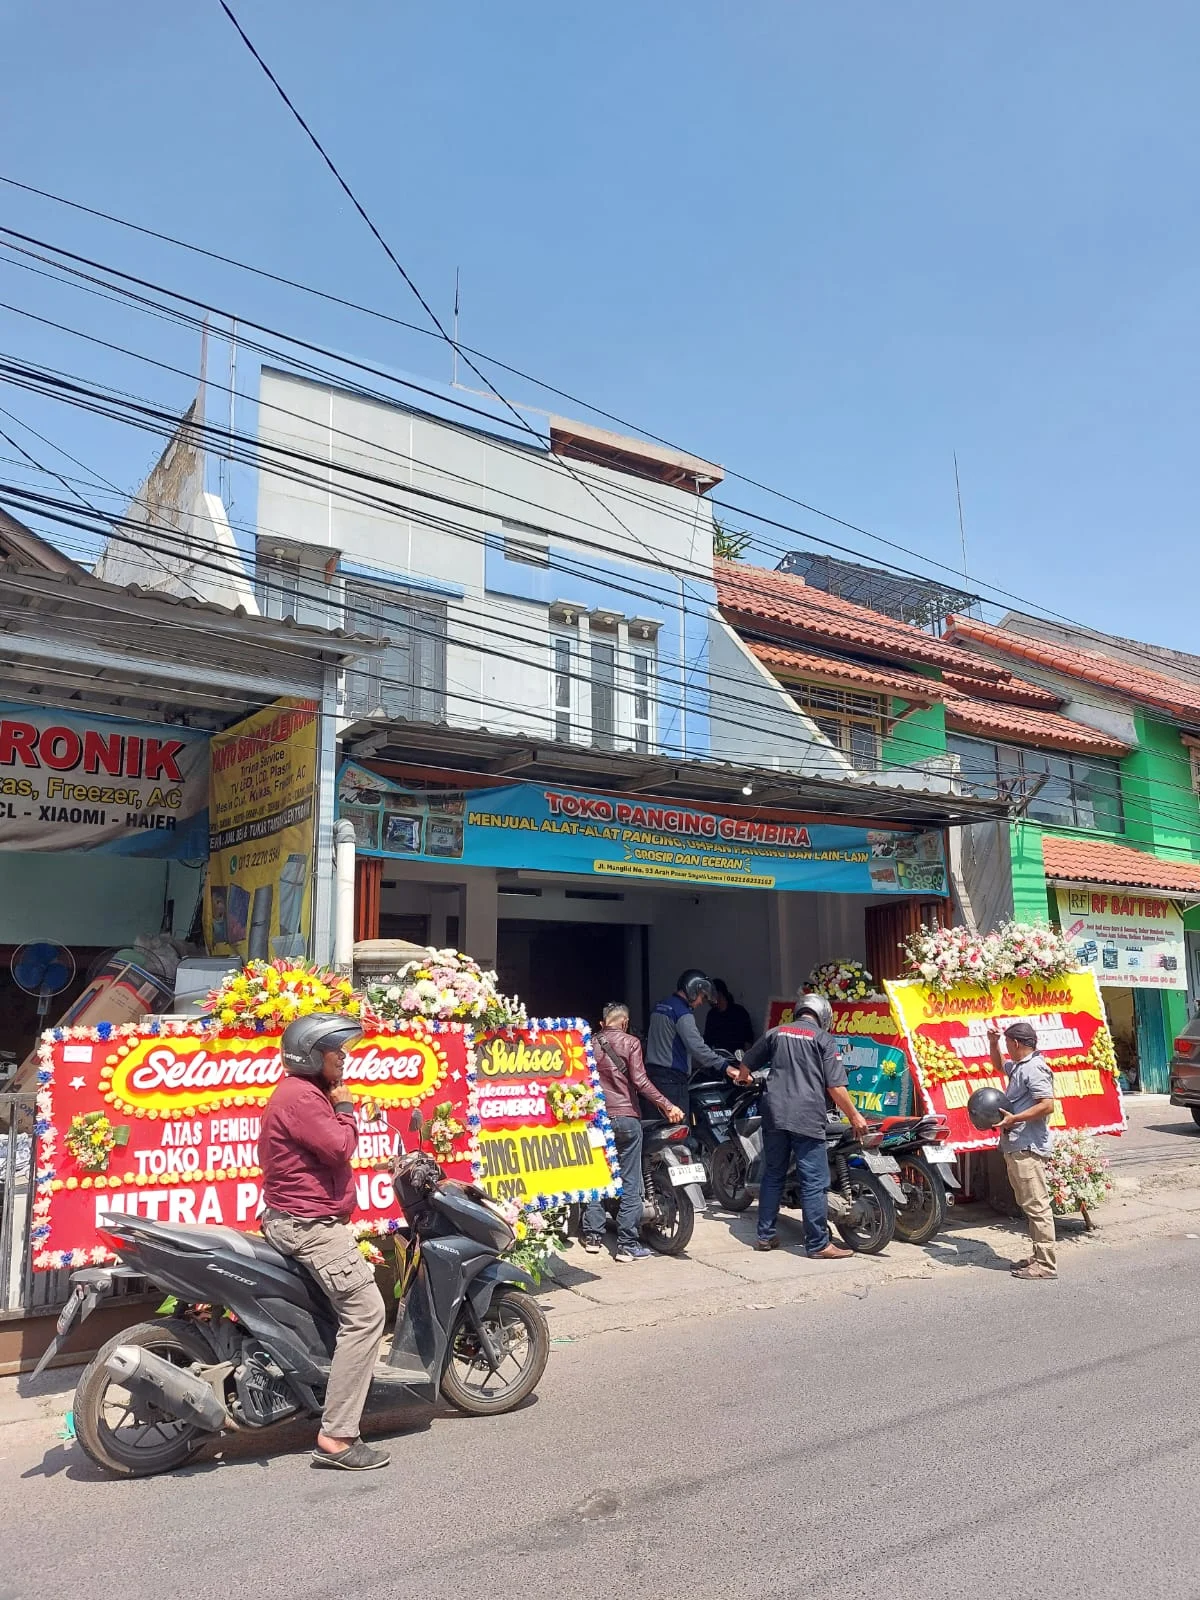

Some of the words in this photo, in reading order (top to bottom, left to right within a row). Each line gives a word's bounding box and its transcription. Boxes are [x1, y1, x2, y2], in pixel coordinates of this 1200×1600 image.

[47, 777, 142, 809] Freezer,
[147, 787, 183, 809] AC
[39, 805, 106, 825] XIAOMI
[126, 812, 177, 831] HAIER
[544, 791, 614, 821] TOKO
[616, 803, 716, 837] PANCING
[718, 817, 812, 847] GEMBIRA
[467, 812, 539, 831] MENJUAL
[540, 819, 622, 842] ALAT-ALAT
[622, 829, 686, 849] PANCING,
[813, 850, 869, 864] LAIN-LAIN
[634, 849, 674, 863] GROSIR
[675, 853, 700, 866] DAN
[702, 856, 744, 870] ECERAN
[1071, 893, 1087, 909] RF
[1091, 893, 1108, 914] RF
[1111, 895, 1169, 919] BATTERY
[1020, 983, 1073, 1009] Sukses
[133, 1049, 283, 1089] Selamat
[342, 1048, 422, 1082] ukses
[481, 1038, 564, 1076] Sukses
[481, 1098, 546, 1119] GEMBIRA
[160, 1121, 203, 1147] ATAS
[134, 1147, 199, 1176] TOKO
[351, 1133, 407, 1159] BIRA
[479, 1137, 520, 1178] CING
[520, 1130, 593, 1173] MARLIN
[95, 1185, 223, 1229] MITRA
